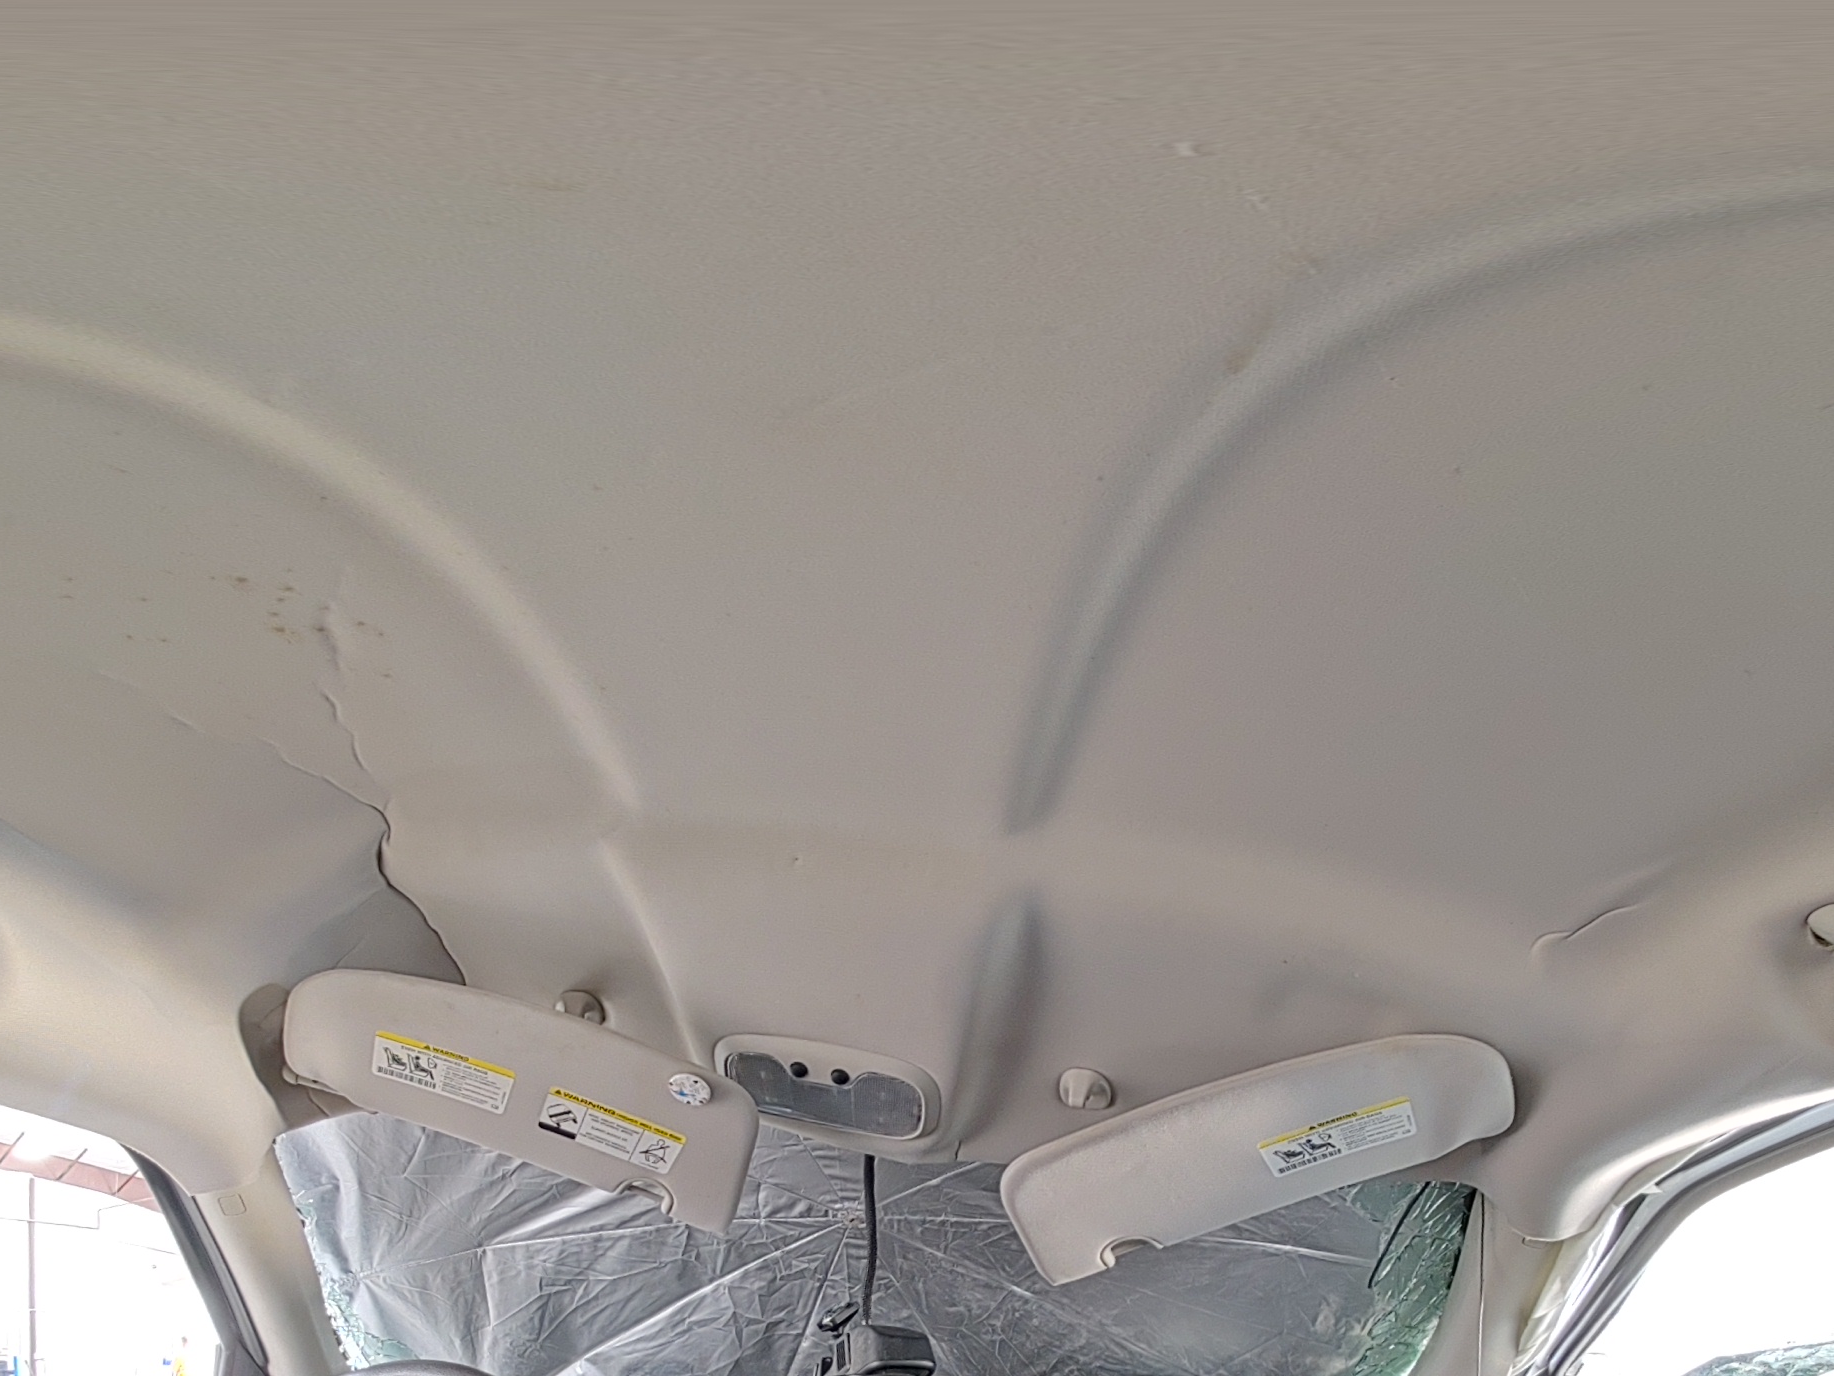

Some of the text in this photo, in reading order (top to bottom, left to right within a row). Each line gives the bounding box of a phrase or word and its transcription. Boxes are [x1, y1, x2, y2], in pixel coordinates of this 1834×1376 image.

[432, 1046, 470, 1062] WARNING
[563, 1091, 616, 1115] WARNING
[1317, 1111, 1358, 1127] WARNING
